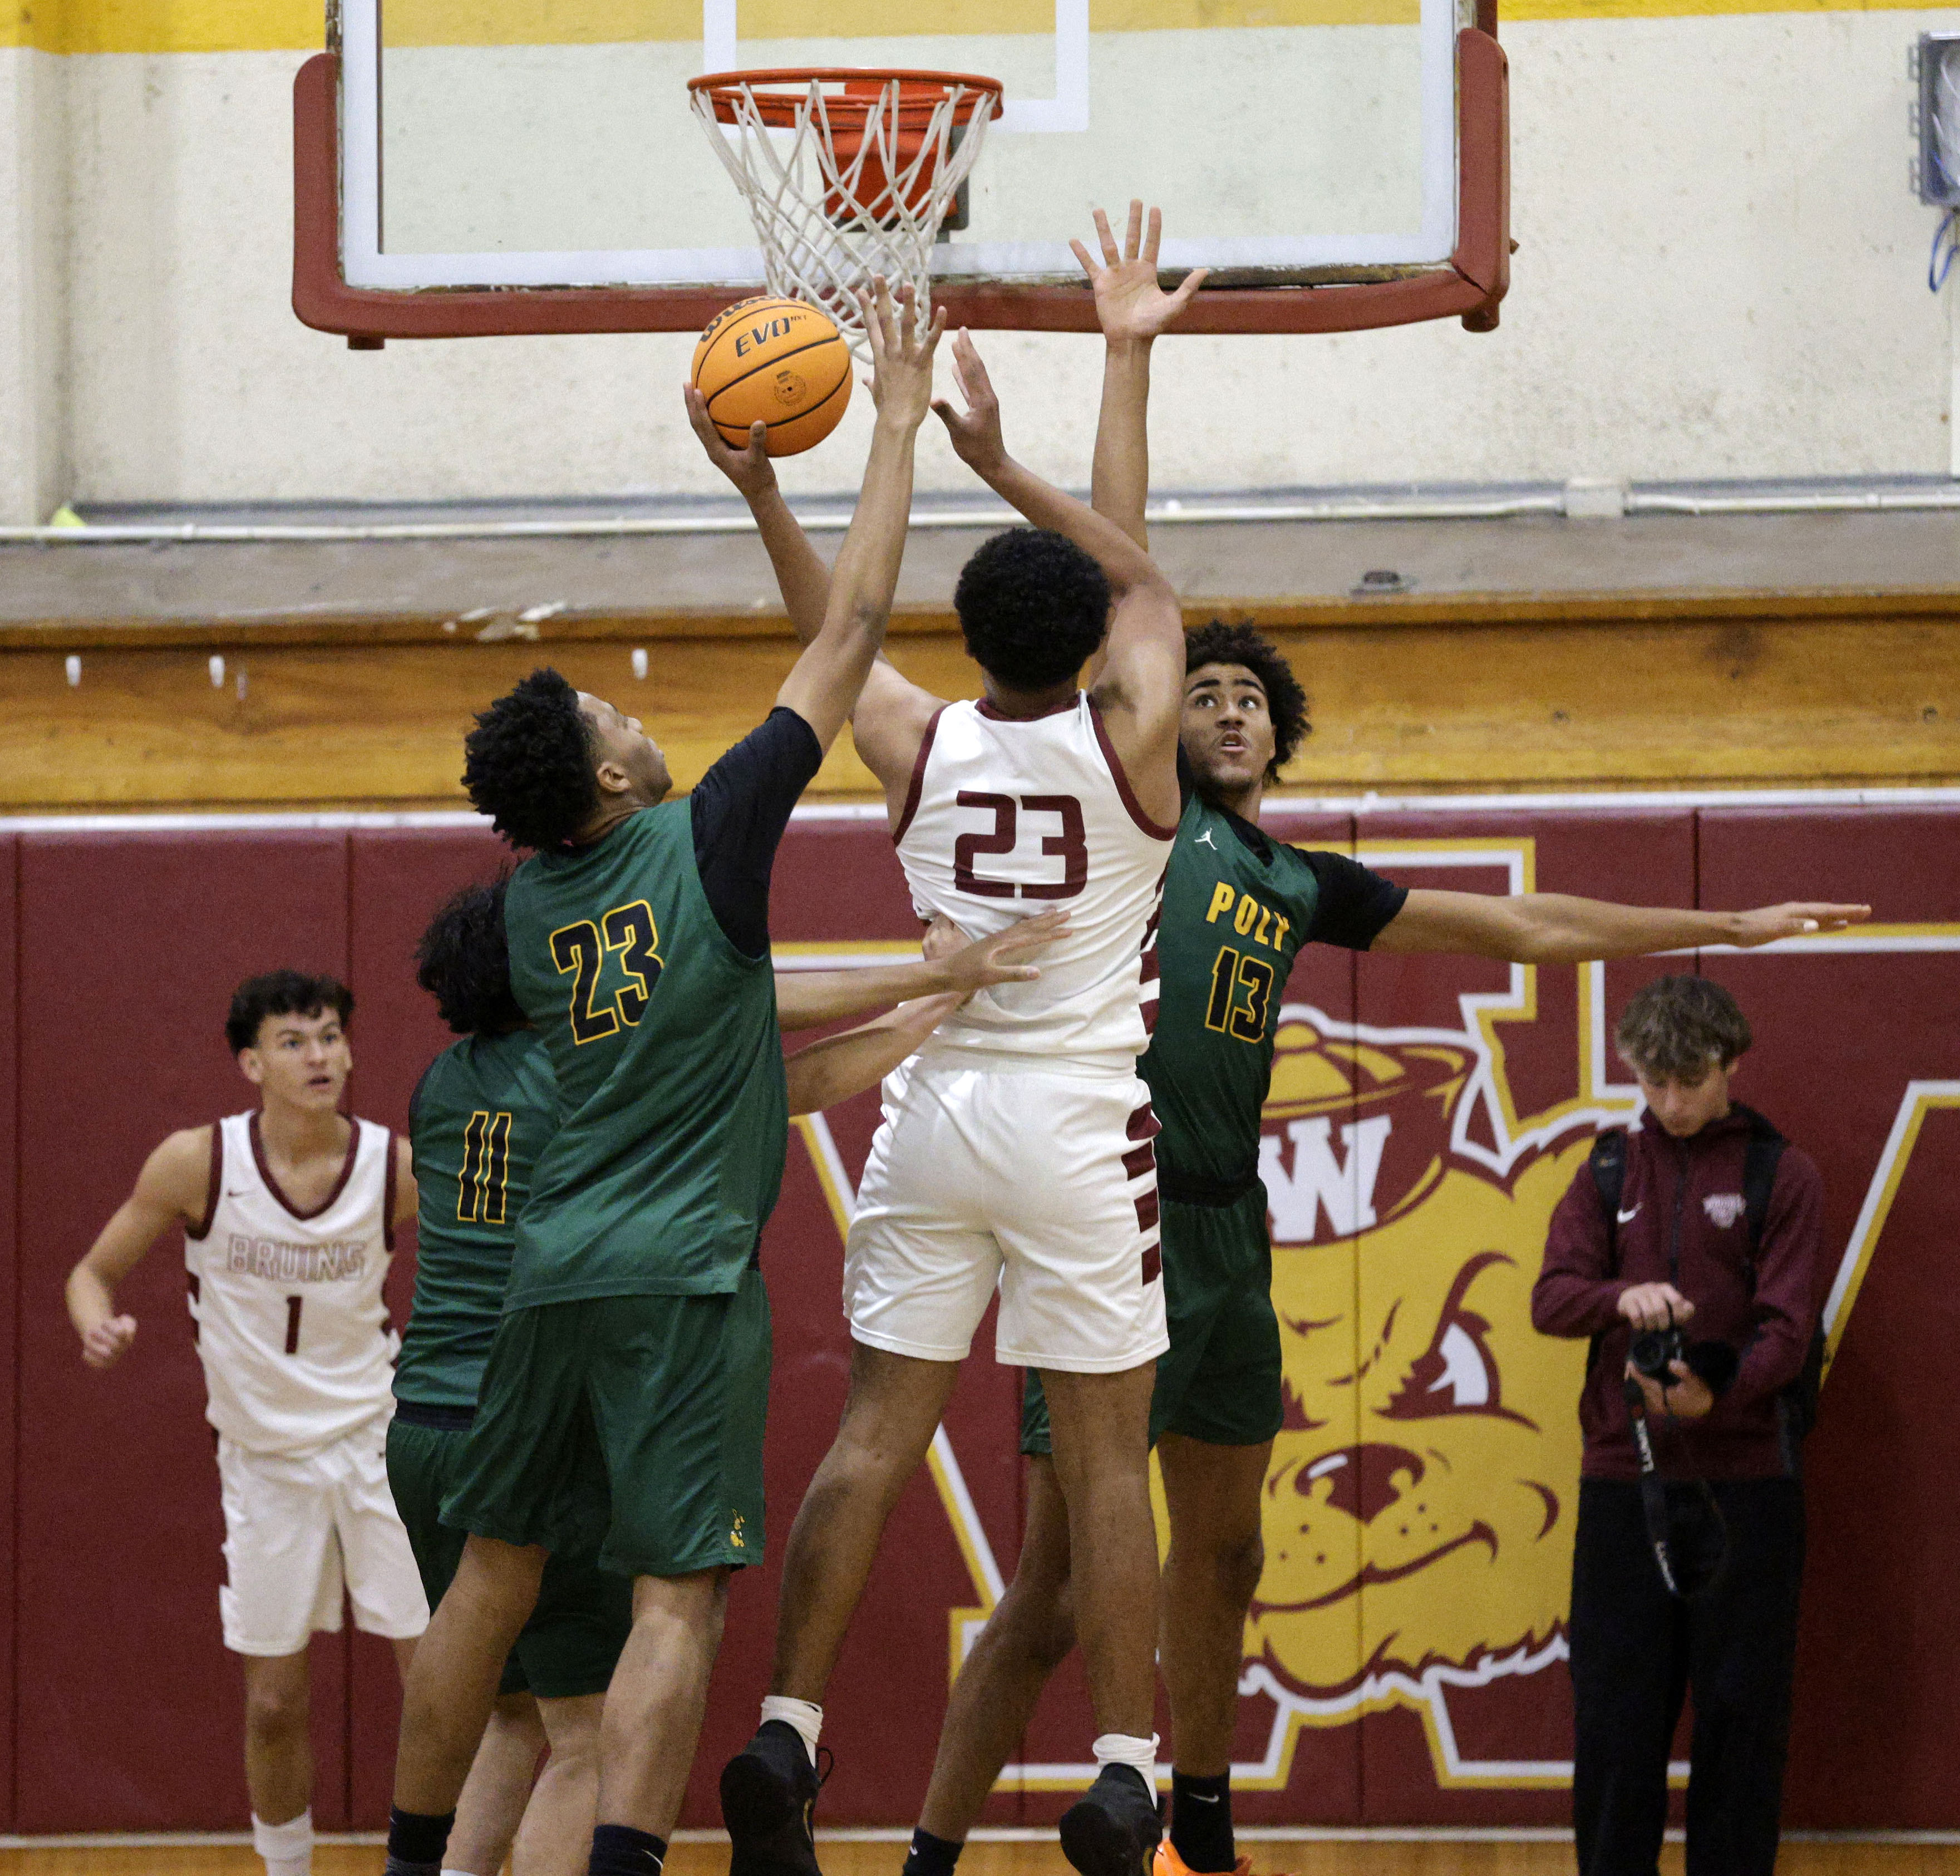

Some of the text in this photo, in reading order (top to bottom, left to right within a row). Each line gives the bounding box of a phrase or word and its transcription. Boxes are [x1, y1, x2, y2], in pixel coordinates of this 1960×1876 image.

[735, 317, 791, 358] EVO
[953, 790, 1088, 900] 23
[1205, 881, 1291, 952] POLY
[549, 899, 665, 1045] 23
[1204, 945, 1274, 1044] 13
[457, 1111, 512, 1224] 11
[1257, 1114, 1392, 1243] W
[227, 1233, 367, 1283] BRUINS
[285, 1294, 303, 1355] 1
